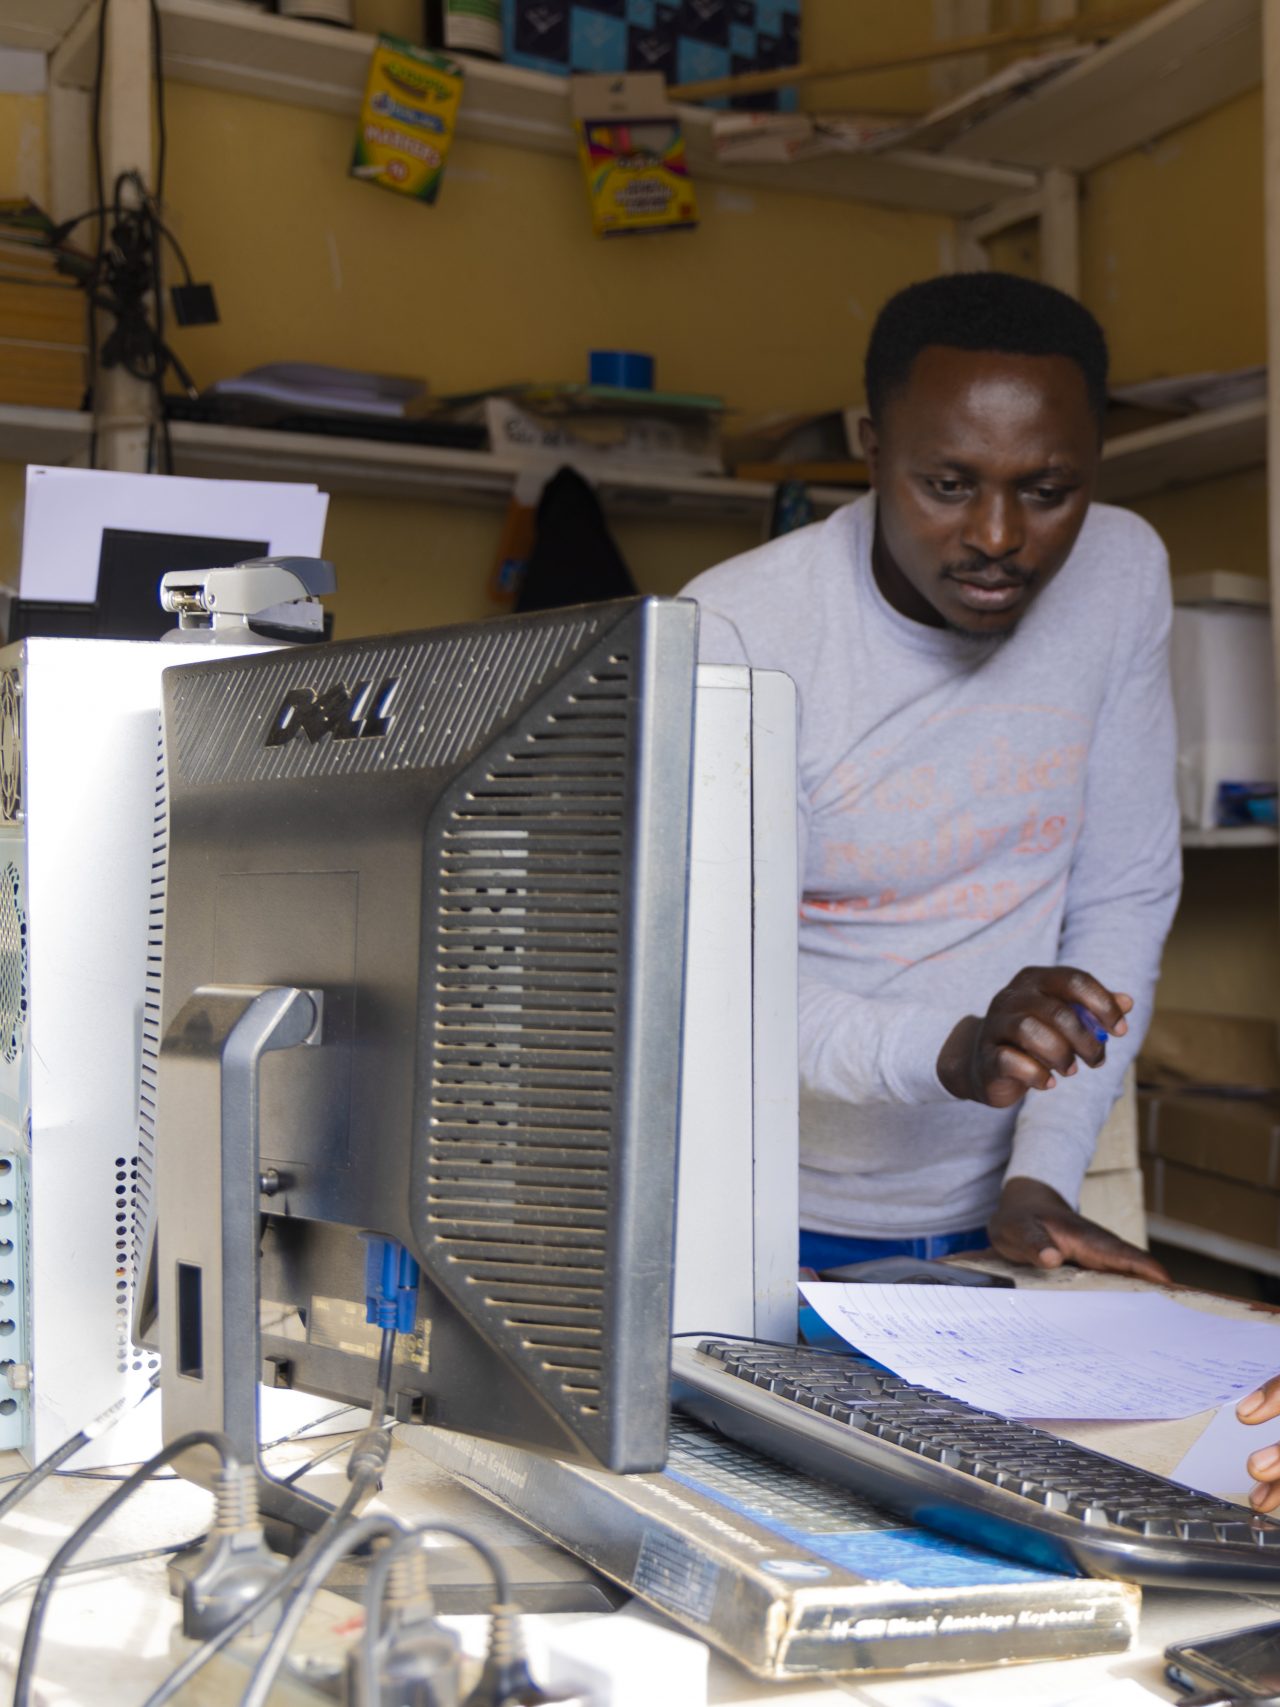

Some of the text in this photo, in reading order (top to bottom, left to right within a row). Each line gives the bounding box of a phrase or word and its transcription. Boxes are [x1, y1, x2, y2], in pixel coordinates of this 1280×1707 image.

[265, 677, 399, 748] DELL
[965, 738, 1090, 798] ther
[1012, 804, 1067, 854] is
[1018, 1605, 1097, 1627] Keyboard
